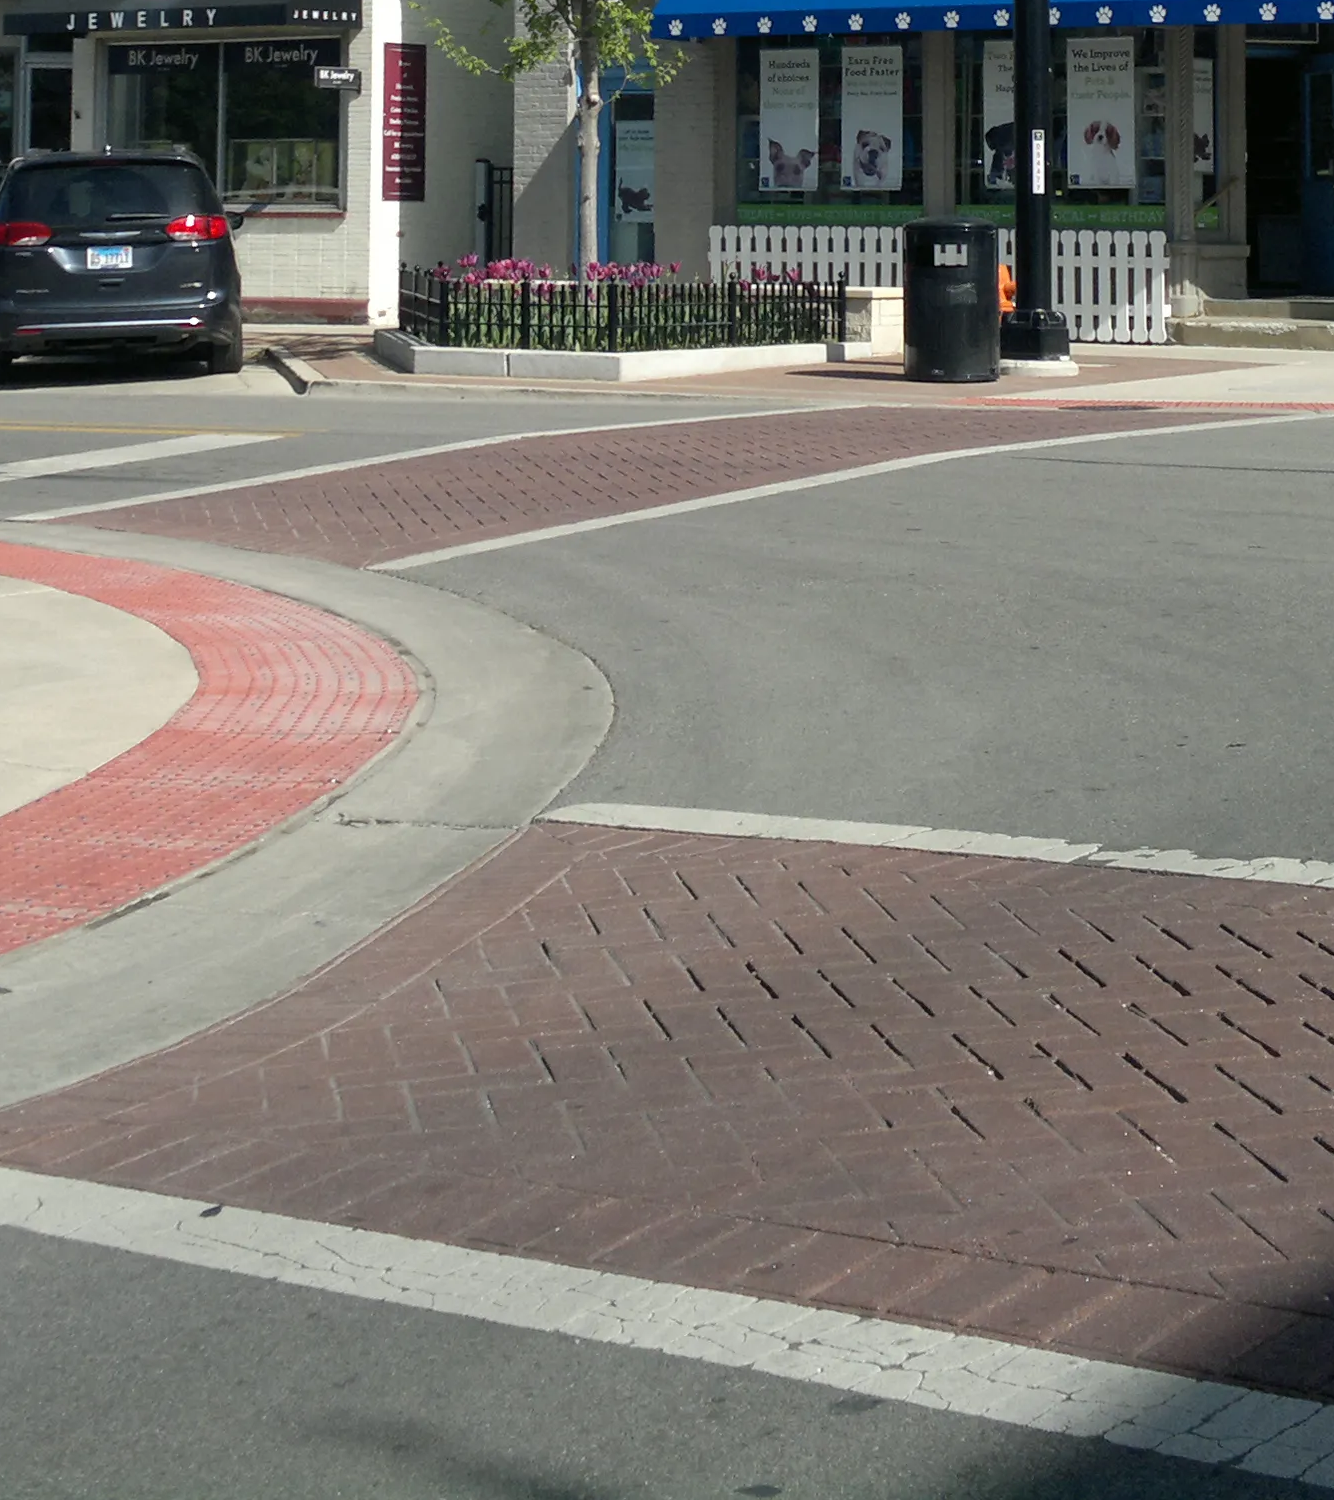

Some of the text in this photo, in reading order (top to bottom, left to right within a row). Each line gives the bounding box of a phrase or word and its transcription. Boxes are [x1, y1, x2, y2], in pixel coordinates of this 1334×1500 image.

[67, 8, 218, 31] JEWELRY
[292, 9, 358, 22] JEWELRY
[128, 49, 199, 70] BK Jewelry
[244, 45, 318, 66] BK Jewelry
[848, 56, 894, 65] Earn Free
[1072, 49, 1130, 61] We Improve
[768, 60, 811, 69] Hundreds
[1073, 61, 1129, 72] the Lives of
[330, 69, 355, 83] Jewelry
[845, 67, 899, 77] Food Faster
[1051, 210, 1086, 223] OCAL
[1099, 210, 1165, 223] BIRTHDAY
